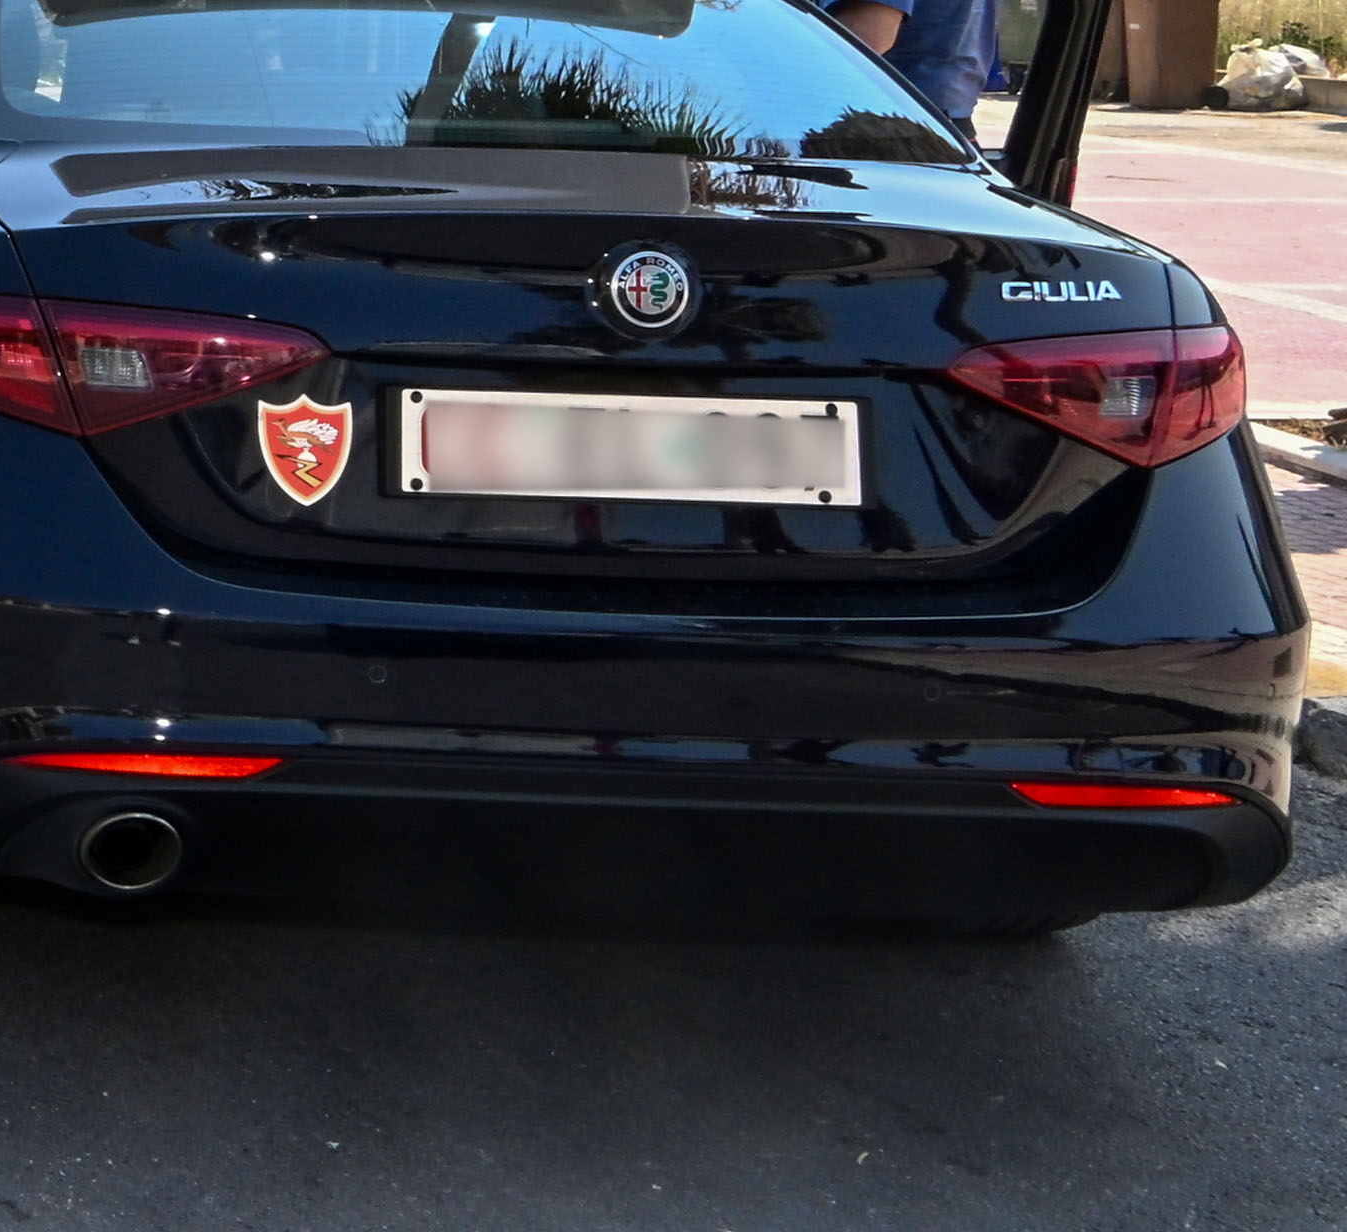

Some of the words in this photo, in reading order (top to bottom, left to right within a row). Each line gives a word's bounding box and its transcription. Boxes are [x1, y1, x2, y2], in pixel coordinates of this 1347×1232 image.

[618, 261, 641, 289] ALFA
[646, 257, 684, 292] ROMEO
[1001, 280, 1122, 301] GIULIA
